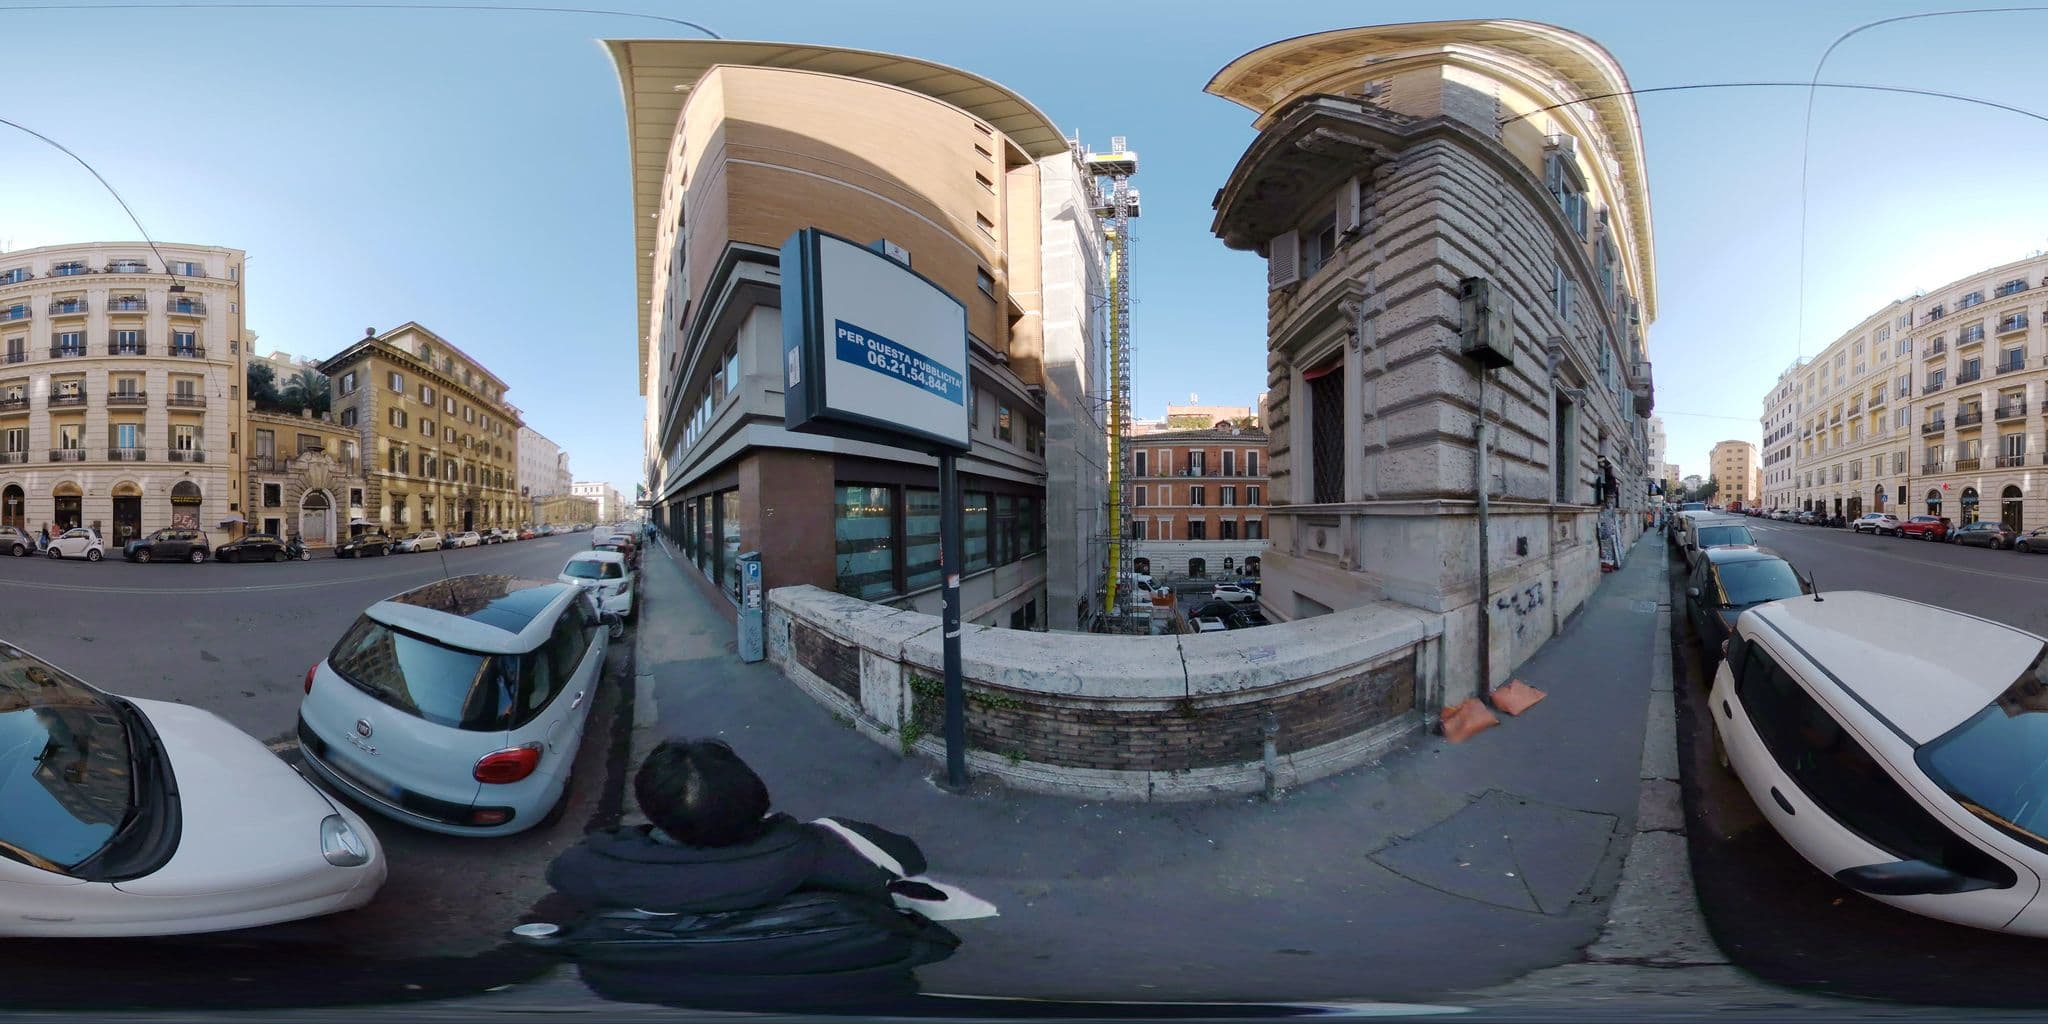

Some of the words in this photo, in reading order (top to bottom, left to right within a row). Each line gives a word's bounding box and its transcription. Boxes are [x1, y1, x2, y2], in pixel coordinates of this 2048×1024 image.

[838, 328, 864, 346] PER
[867, 339, 911, 365] QUESTA
[913, 358, 962, 388] PUBBLICITA'
[867, 351, 948, 393] 06.21.54.844
[749, 563, 757, 575] P
